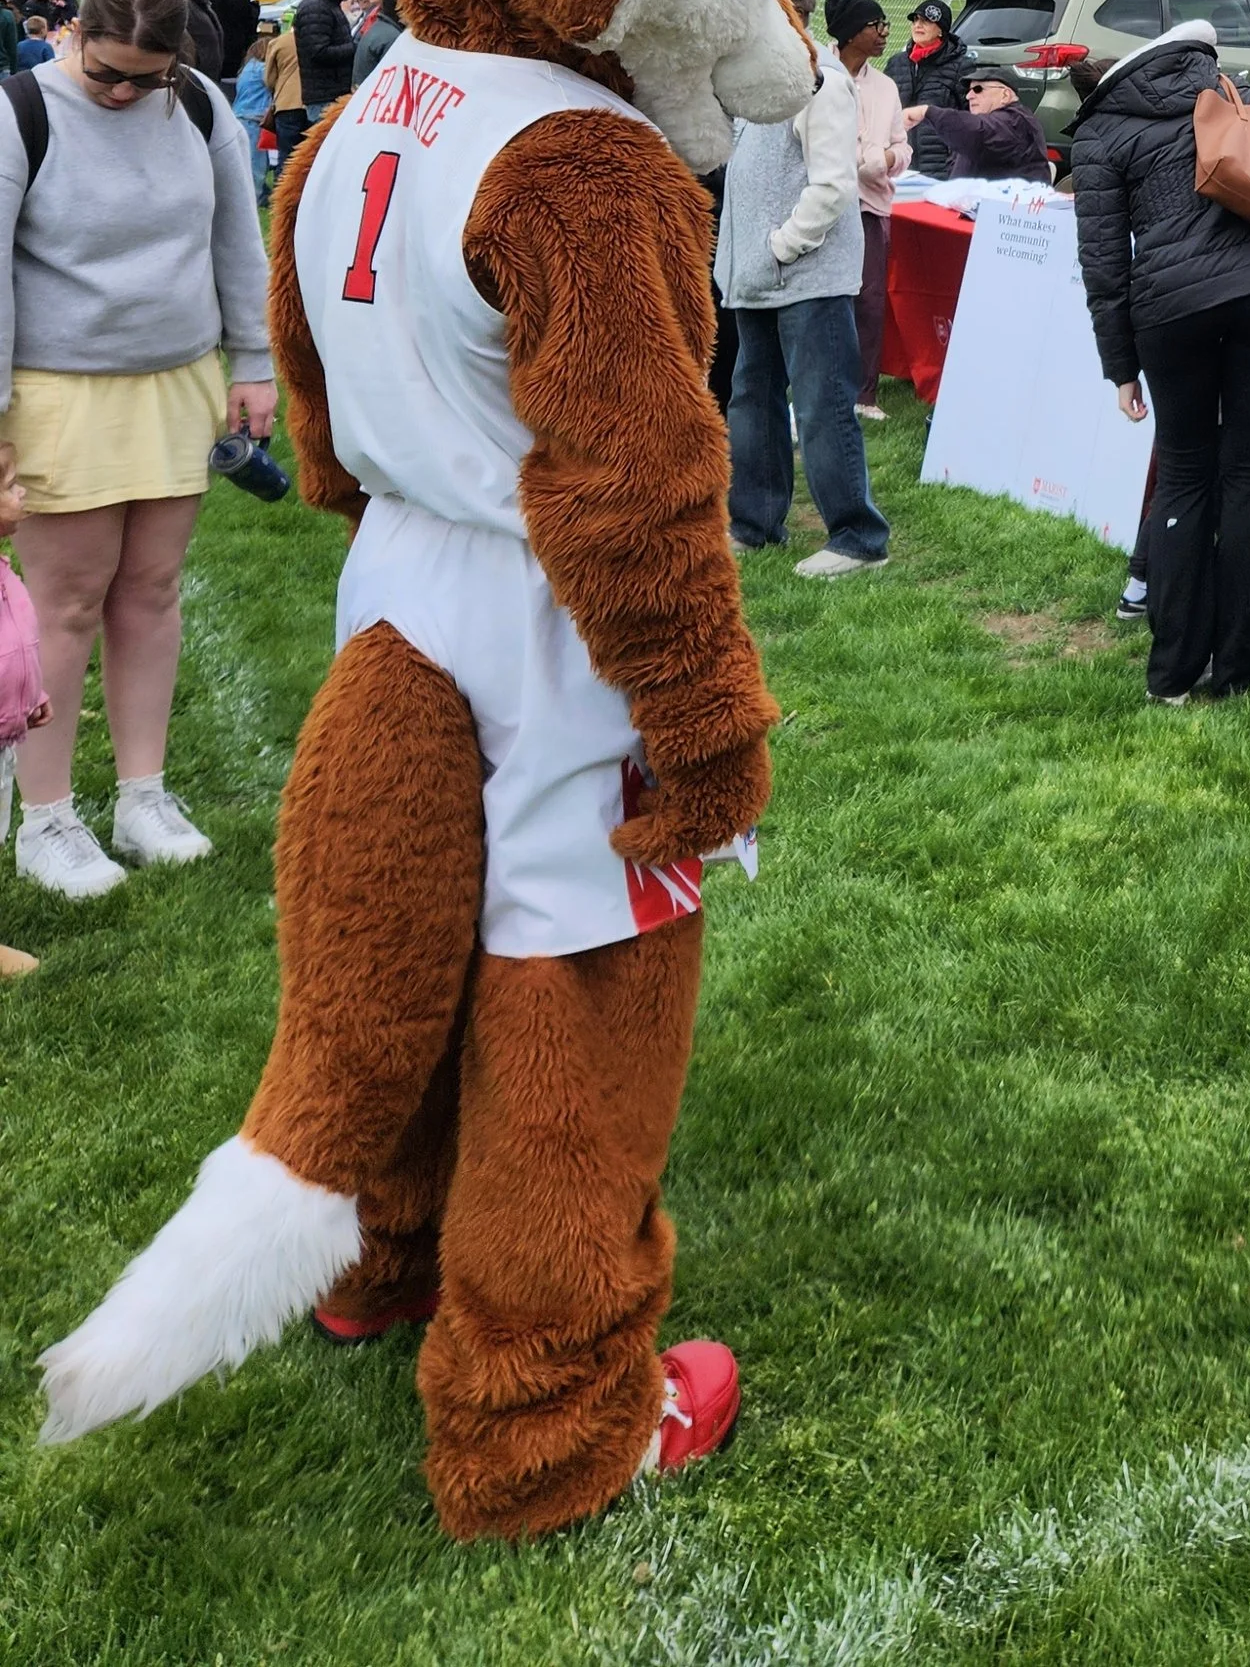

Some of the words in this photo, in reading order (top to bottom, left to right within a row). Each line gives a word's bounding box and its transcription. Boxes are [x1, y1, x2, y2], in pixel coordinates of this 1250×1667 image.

[342, 150, 401, 305] 1
[998, 213, 1022, 228] What
[1000, 231, 1051, 251] community
